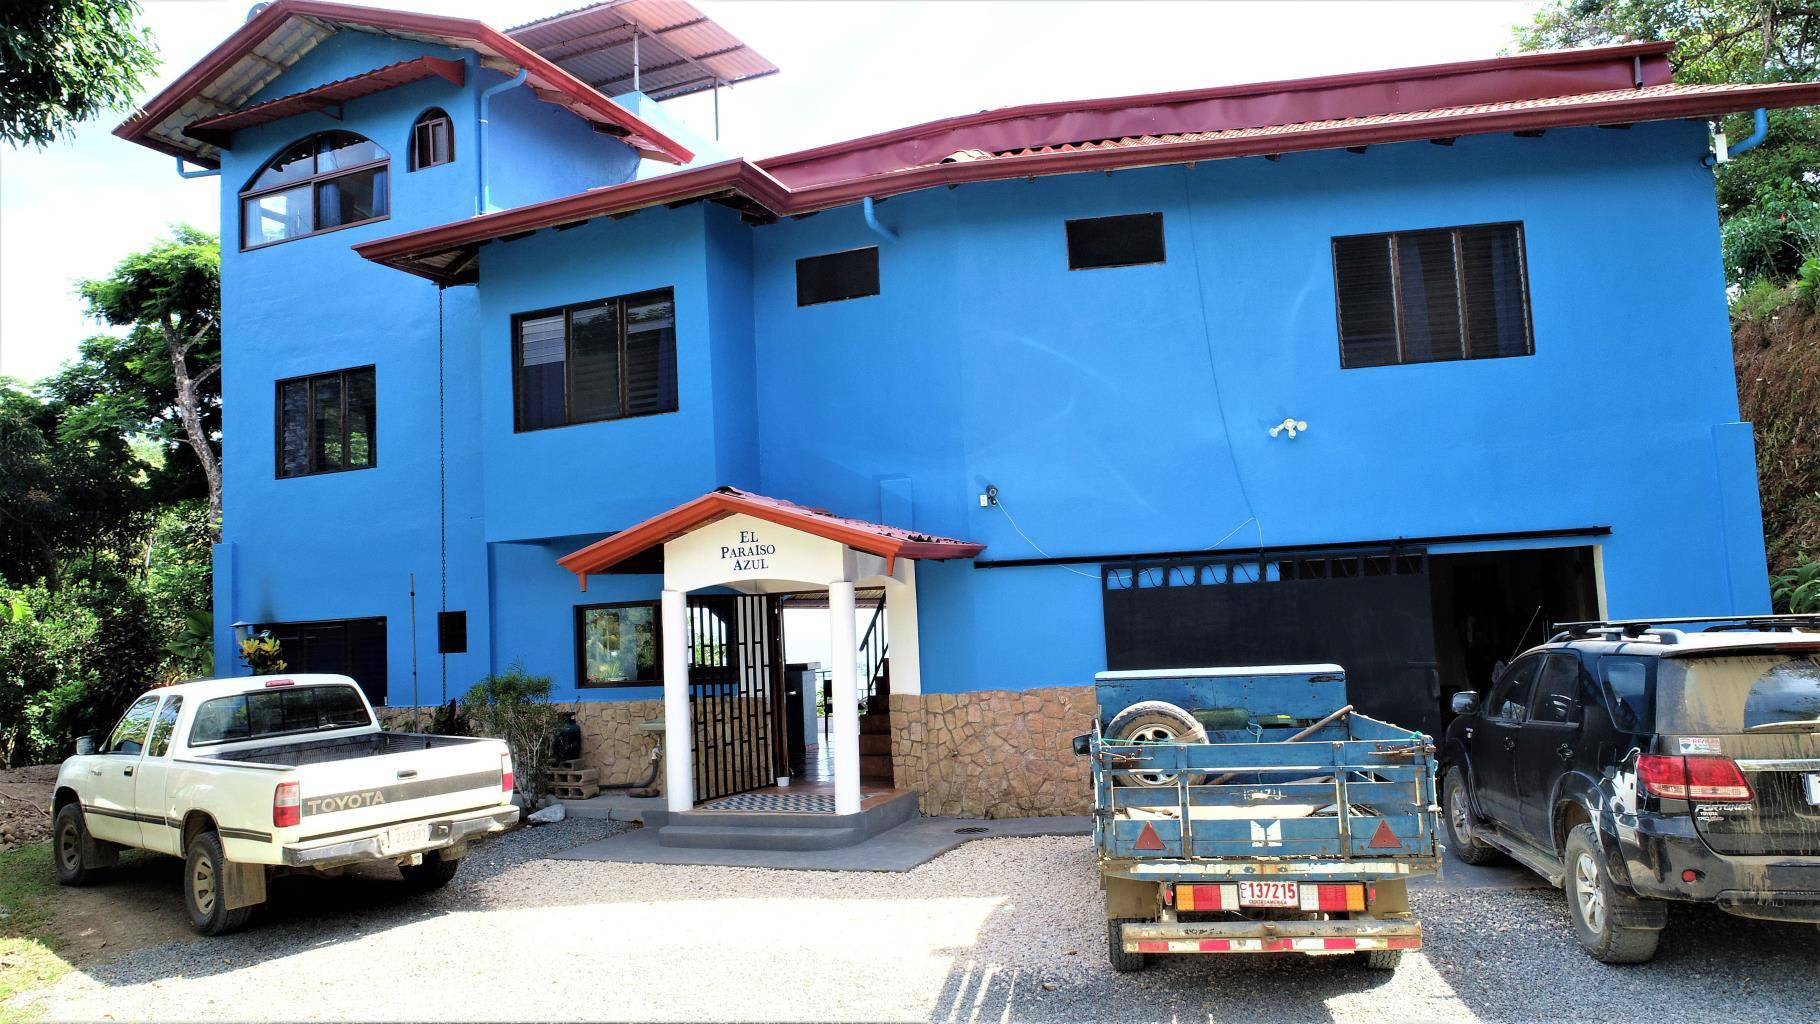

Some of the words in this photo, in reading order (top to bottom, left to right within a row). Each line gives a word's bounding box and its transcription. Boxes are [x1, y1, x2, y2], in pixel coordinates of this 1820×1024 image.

[740, 531, 759, 543] EL
[721, 545, 776, 559] PARAISO
[733, 559, 769, 571] AZUL
[307, 791, 386, 815] TOYOTA
[1695, 803, 1753, 812] FORTUNER
[1249, 883, 1296, 899] 137215
